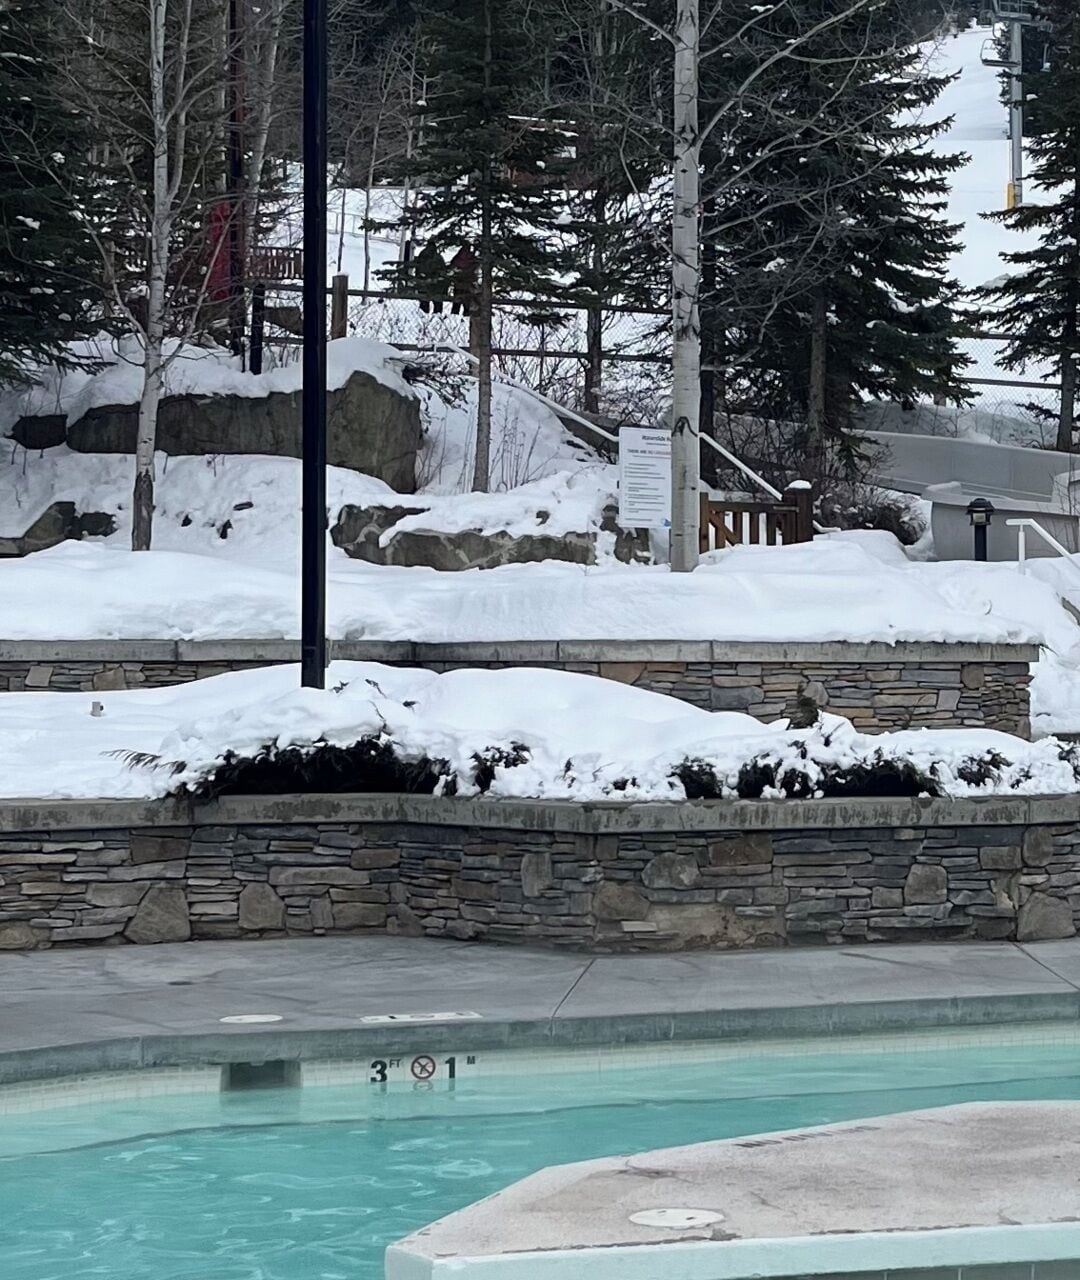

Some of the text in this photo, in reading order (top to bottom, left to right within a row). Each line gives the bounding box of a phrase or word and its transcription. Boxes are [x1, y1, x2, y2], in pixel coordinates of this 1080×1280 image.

[370, 1055, 476, 1082] 3 FT 1 M
